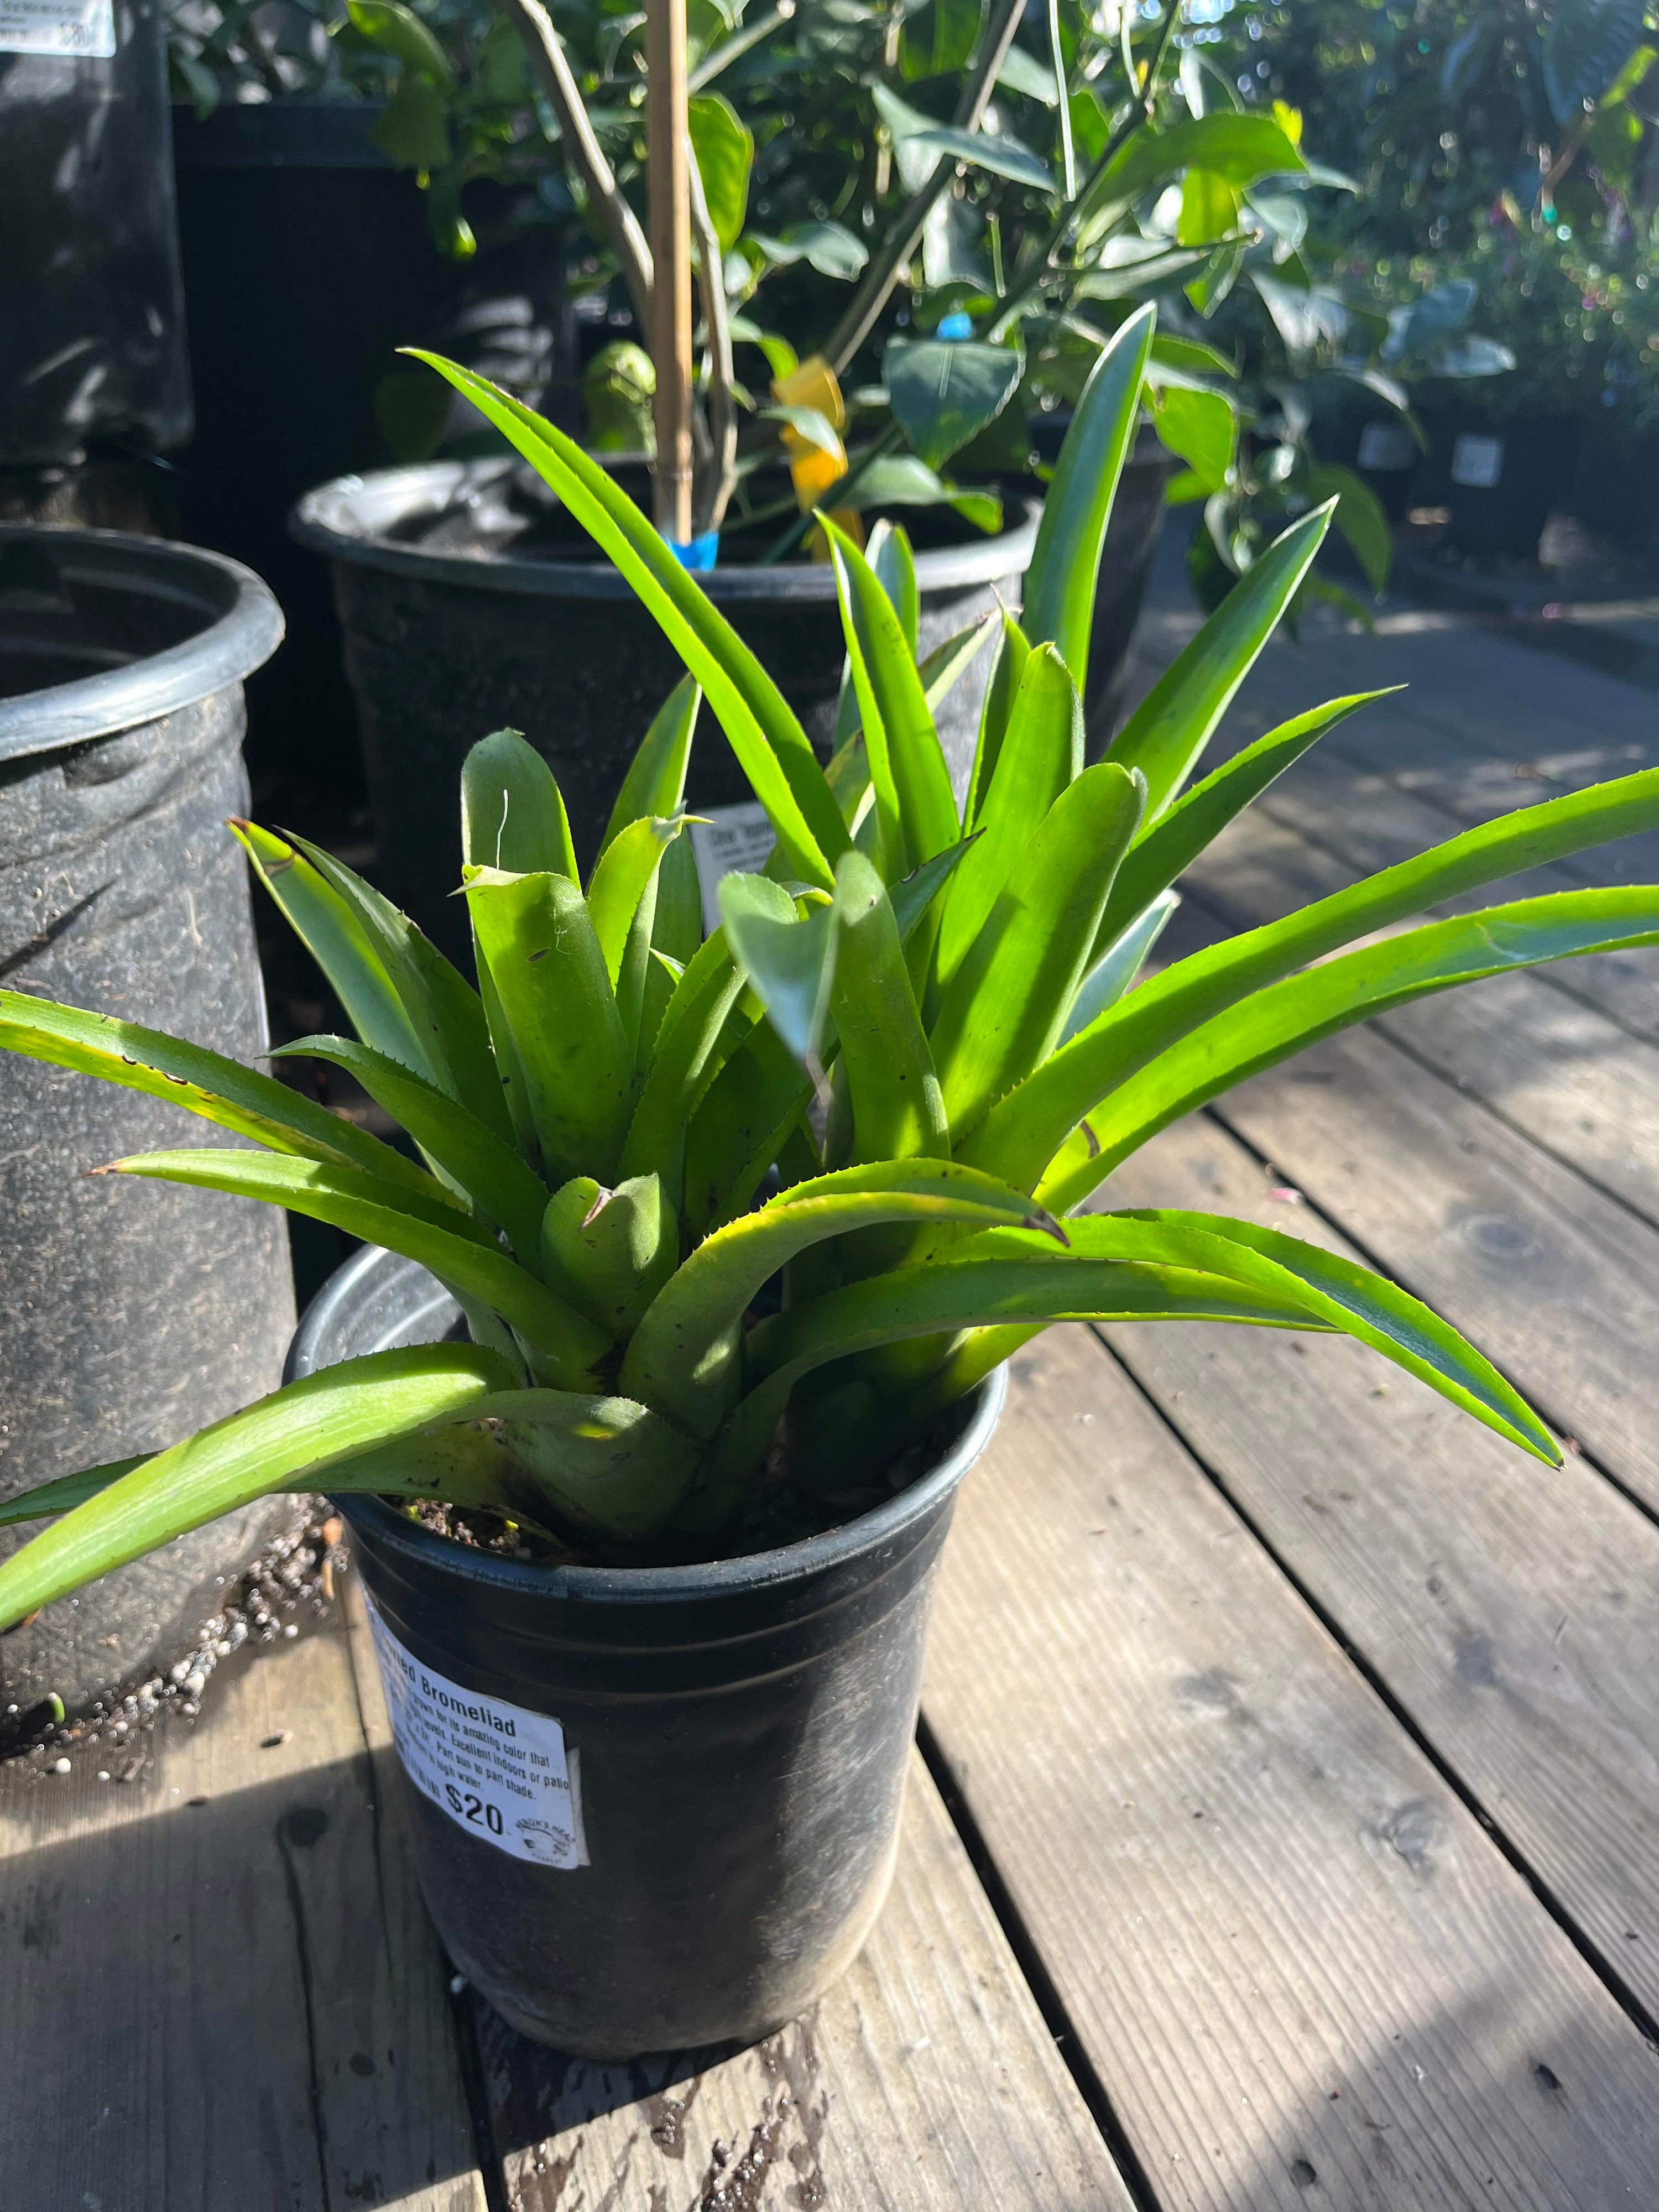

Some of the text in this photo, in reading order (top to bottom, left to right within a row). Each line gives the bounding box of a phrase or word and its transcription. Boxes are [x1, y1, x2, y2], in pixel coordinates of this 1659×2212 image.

[421, 1674, 517, 1738] Bromeliad
[451, 1734, 491, 1761] Excellent
[493, 1752, 527, 1779] indoors
[530, 1772, 540, 1783] or
[544, 1776, 570, 1790] patio
[456, 1755, 472, 1769] sun
[474, 1763, 483, 1775] to
[486, 1768, 503, 1786] part
[463, 1725, 500, 1751] amazing
[503, 1743, 526, 1761] color
[530, 1751, 550, 1768] that
[445, 1783, 504, 1836] $20
